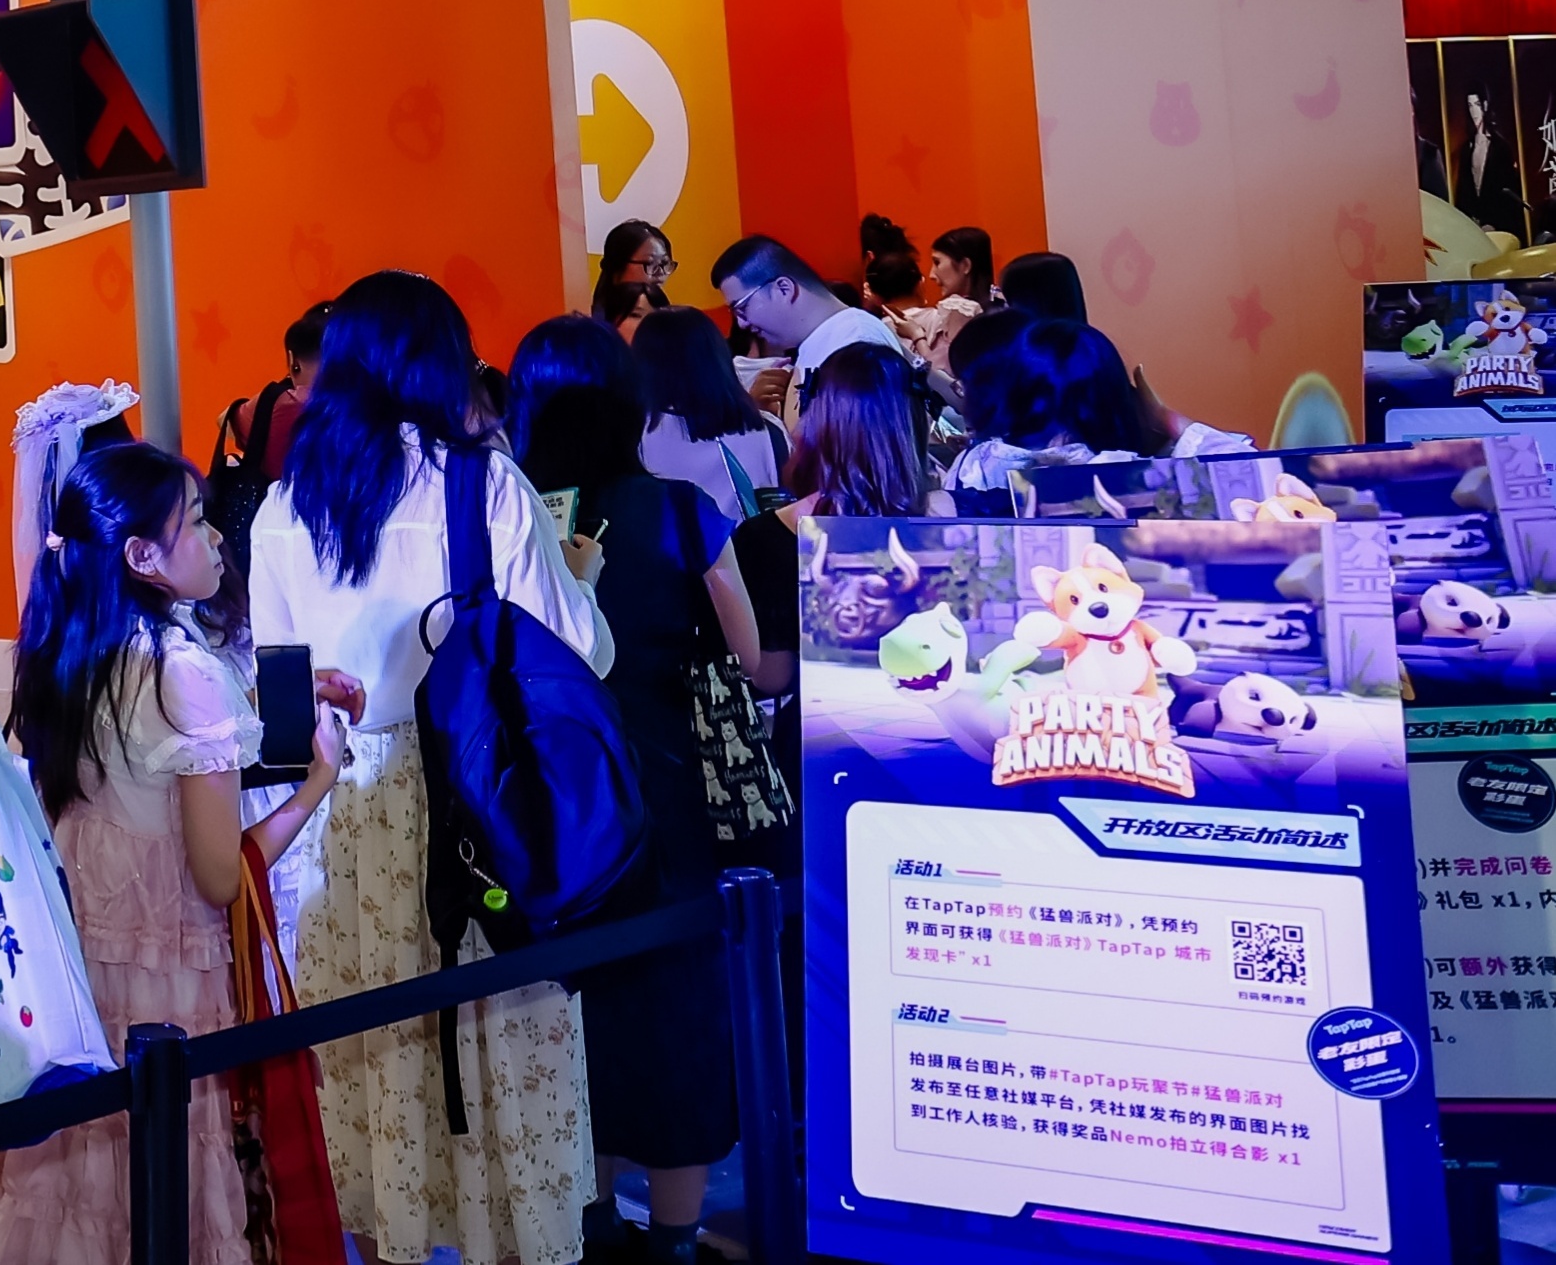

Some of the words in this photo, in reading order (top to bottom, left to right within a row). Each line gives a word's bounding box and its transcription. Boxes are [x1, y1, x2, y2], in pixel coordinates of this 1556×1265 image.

[1466, 352, 1536, 374] PARTY
[1457, 371, 1539, 392] ANIMALS
[1019, 694, 1163, 742] PARTY
[1001, 733, 1184, 787] ANIMALS
[1103, 816, 1349, 850] 开放区活动简述
[894, 858, 943, 878] 活动1
[971, 954, 992, 967] x1
[1174, 944, 1213, 964] 城市
[1238, 991, 1307, 1006] 扫码预约游戏
[898, 1002, 950, 1024] 活动2
[1323, 1017, 1373, 1035] TapTap
[1277, 1151, 1302, 1166] x1
